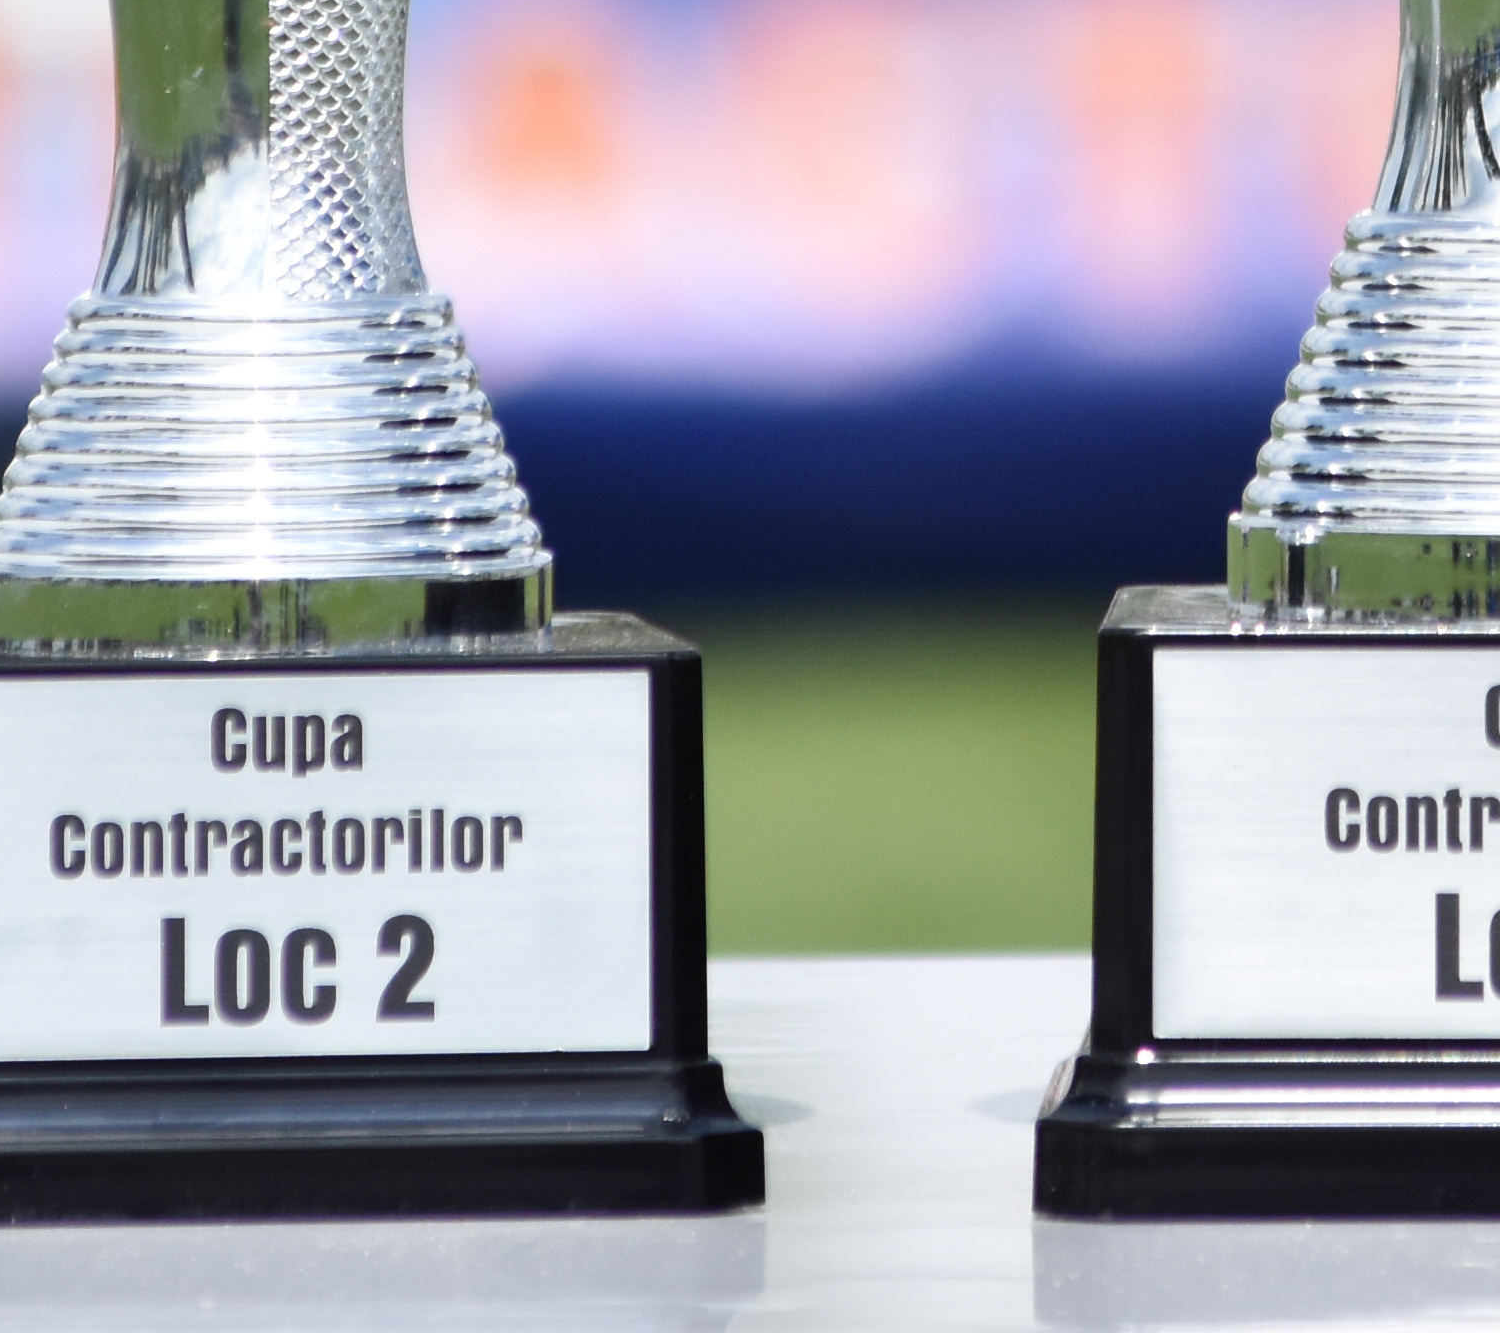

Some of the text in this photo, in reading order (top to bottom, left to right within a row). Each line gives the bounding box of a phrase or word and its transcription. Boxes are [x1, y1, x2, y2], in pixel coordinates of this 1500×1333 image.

[212, 708, 362, 775] Cupa
[52, 811, 522, 876] Contractorilor
[378, 913, 436, 1021] 2
